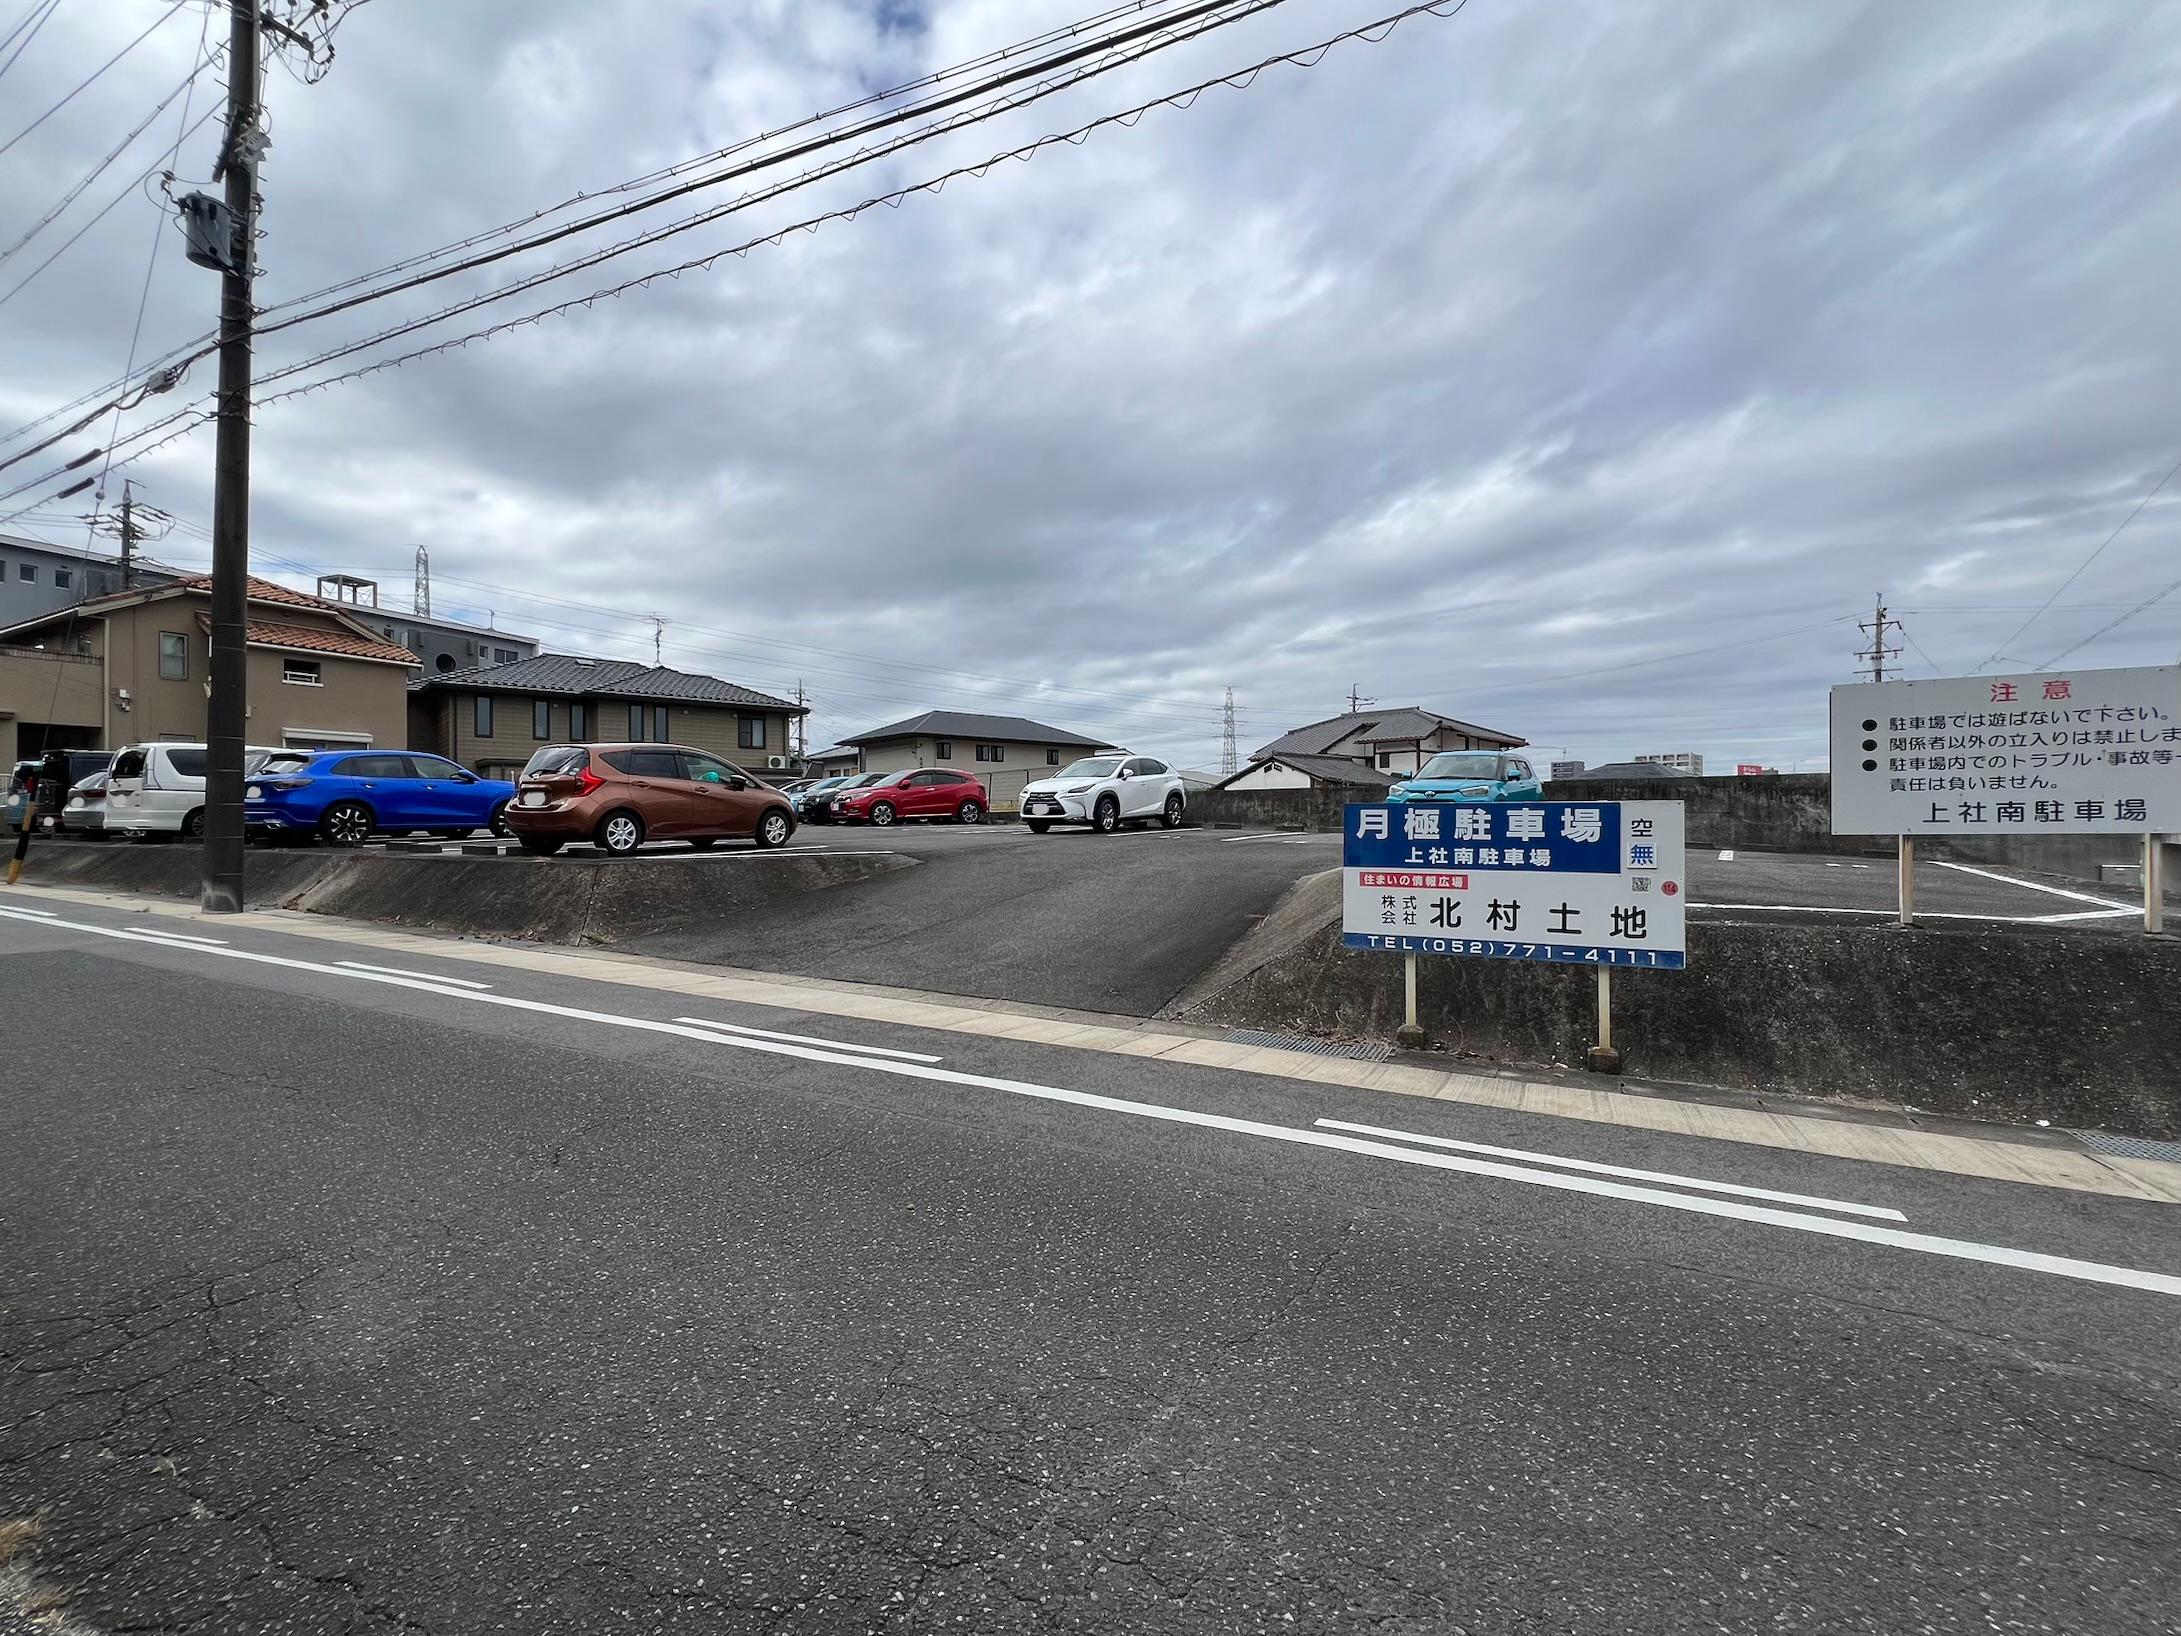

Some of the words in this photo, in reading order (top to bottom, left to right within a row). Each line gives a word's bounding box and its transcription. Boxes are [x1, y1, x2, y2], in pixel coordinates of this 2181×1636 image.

[1990, 680, 2072, 703] 注意
[1889, 706, 2169, 731] 駐車場では遊ばないで下さい。
[1889, 749, 2181, 772] 駐車場内でのトラブル・事故等
[1889, 775, 2059, 792] 責任は負いません。
[1922, 798, 2148, 824] 上社南駐車場
[1356, 807, 1602, 843] 月極駐車場
[1631, 818, 1653, 837] 空
[1404, 846, 1552, 867] 上社南駐車場
[1630, 844, 1654, 866] 無
[1363, 874, 1464, 888] 住まいの情報広場
[1430, 897, 1648, 939] 北村土地
